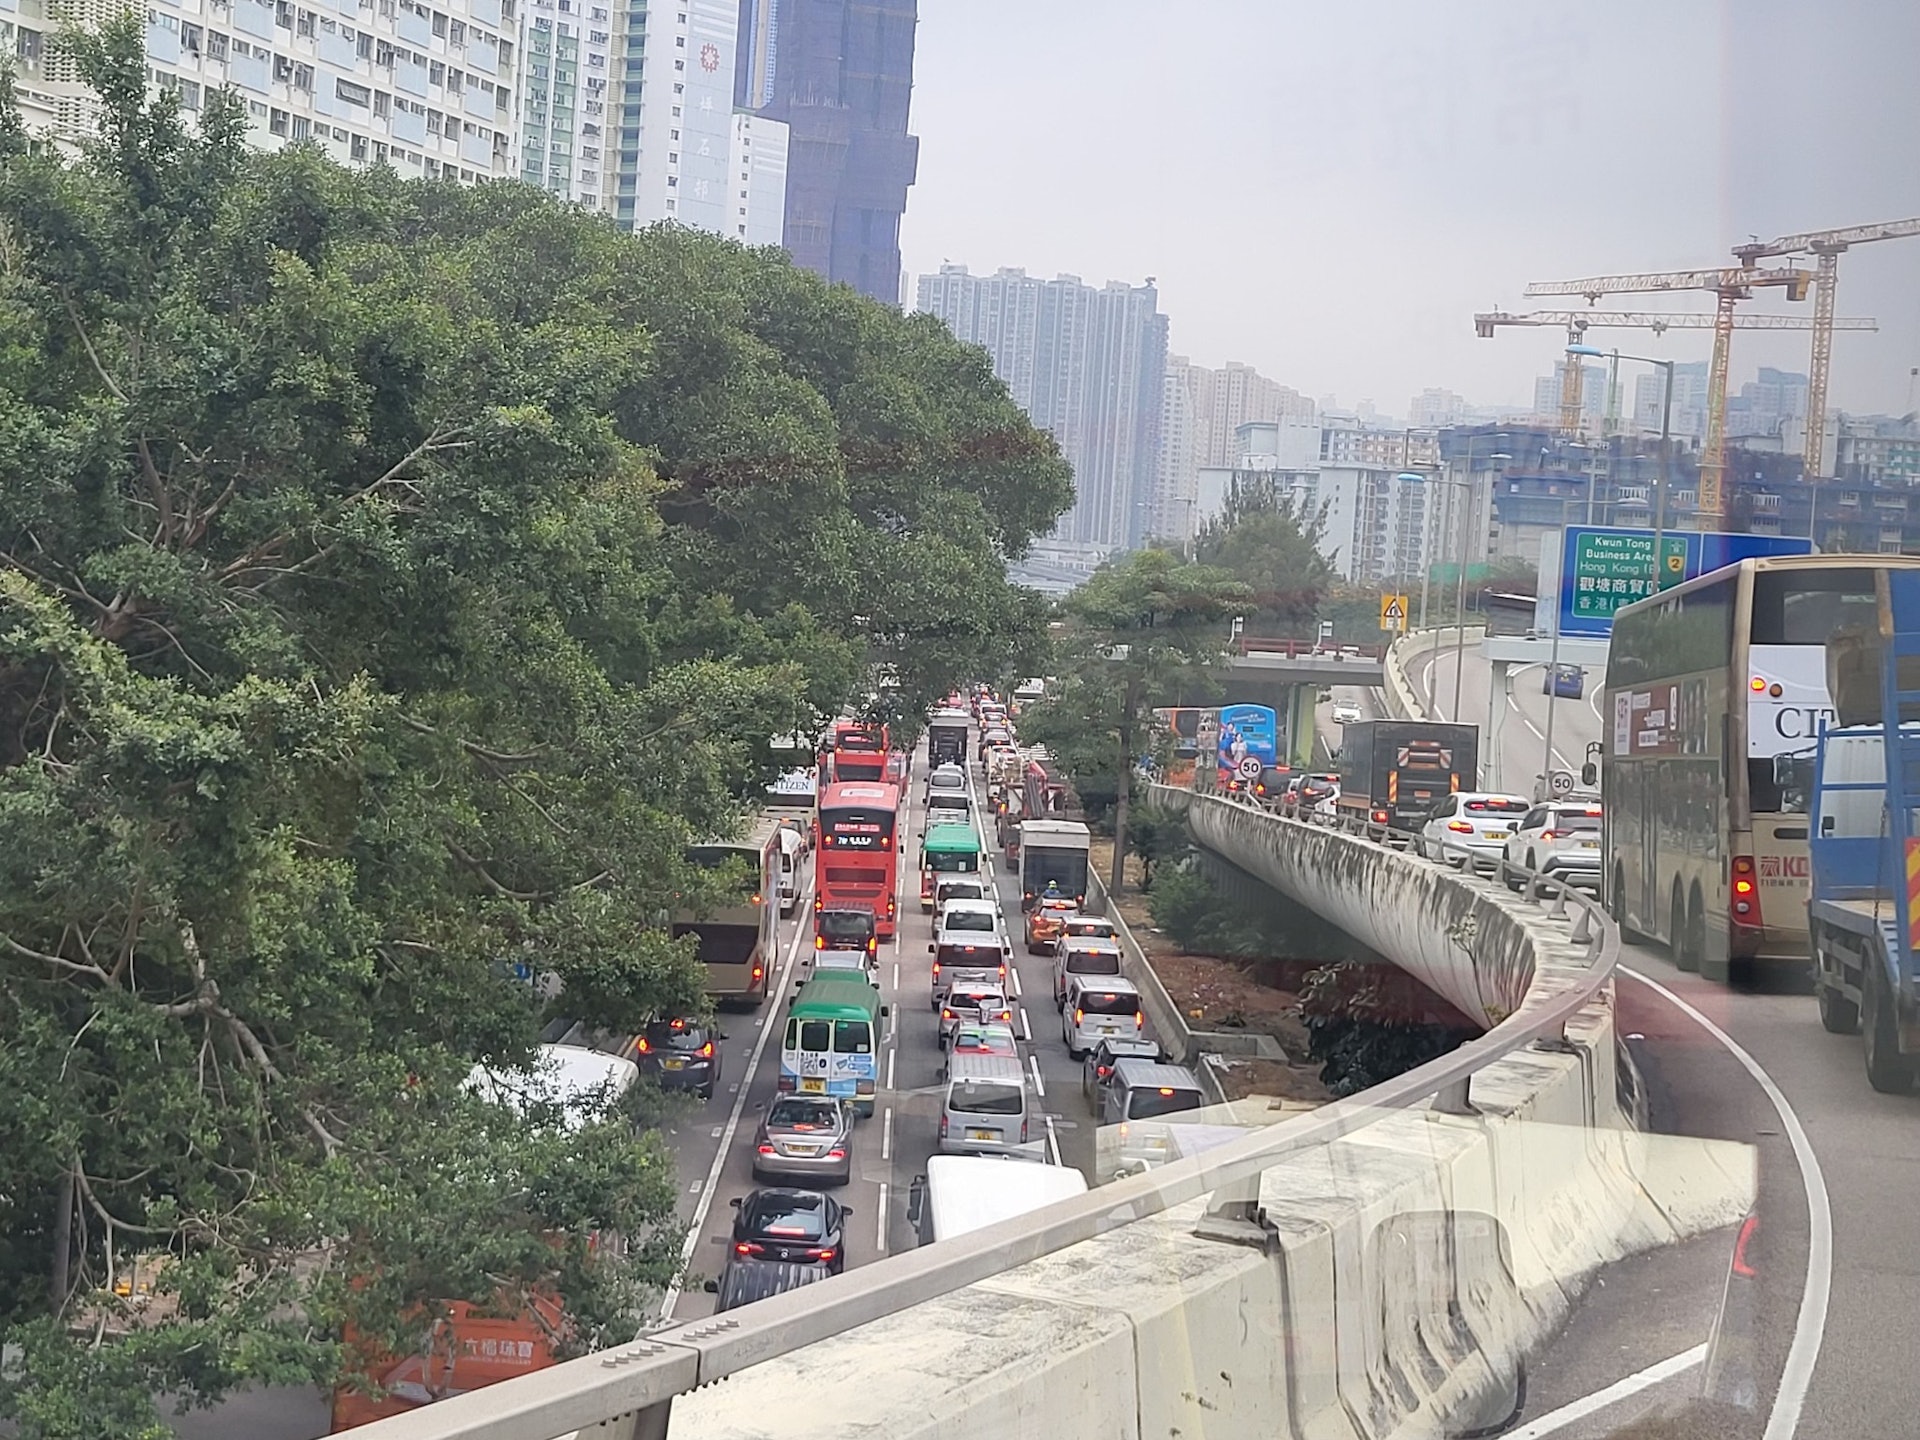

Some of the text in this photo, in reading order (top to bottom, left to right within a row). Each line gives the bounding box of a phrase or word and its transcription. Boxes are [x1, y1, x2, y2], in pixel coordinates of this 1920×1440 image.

[1594, 536, 1652, 551] Kwun Tong
[1586, 549, 1631, 560] Business
[1580, 561, 1606, 573] Hong
[1612, 563, 1640, 575] Kong
[1671, 558, 1681, 569] 2
[1243, 762, 1259, 773] 50
[1554, 778, 1571, 789] 50
